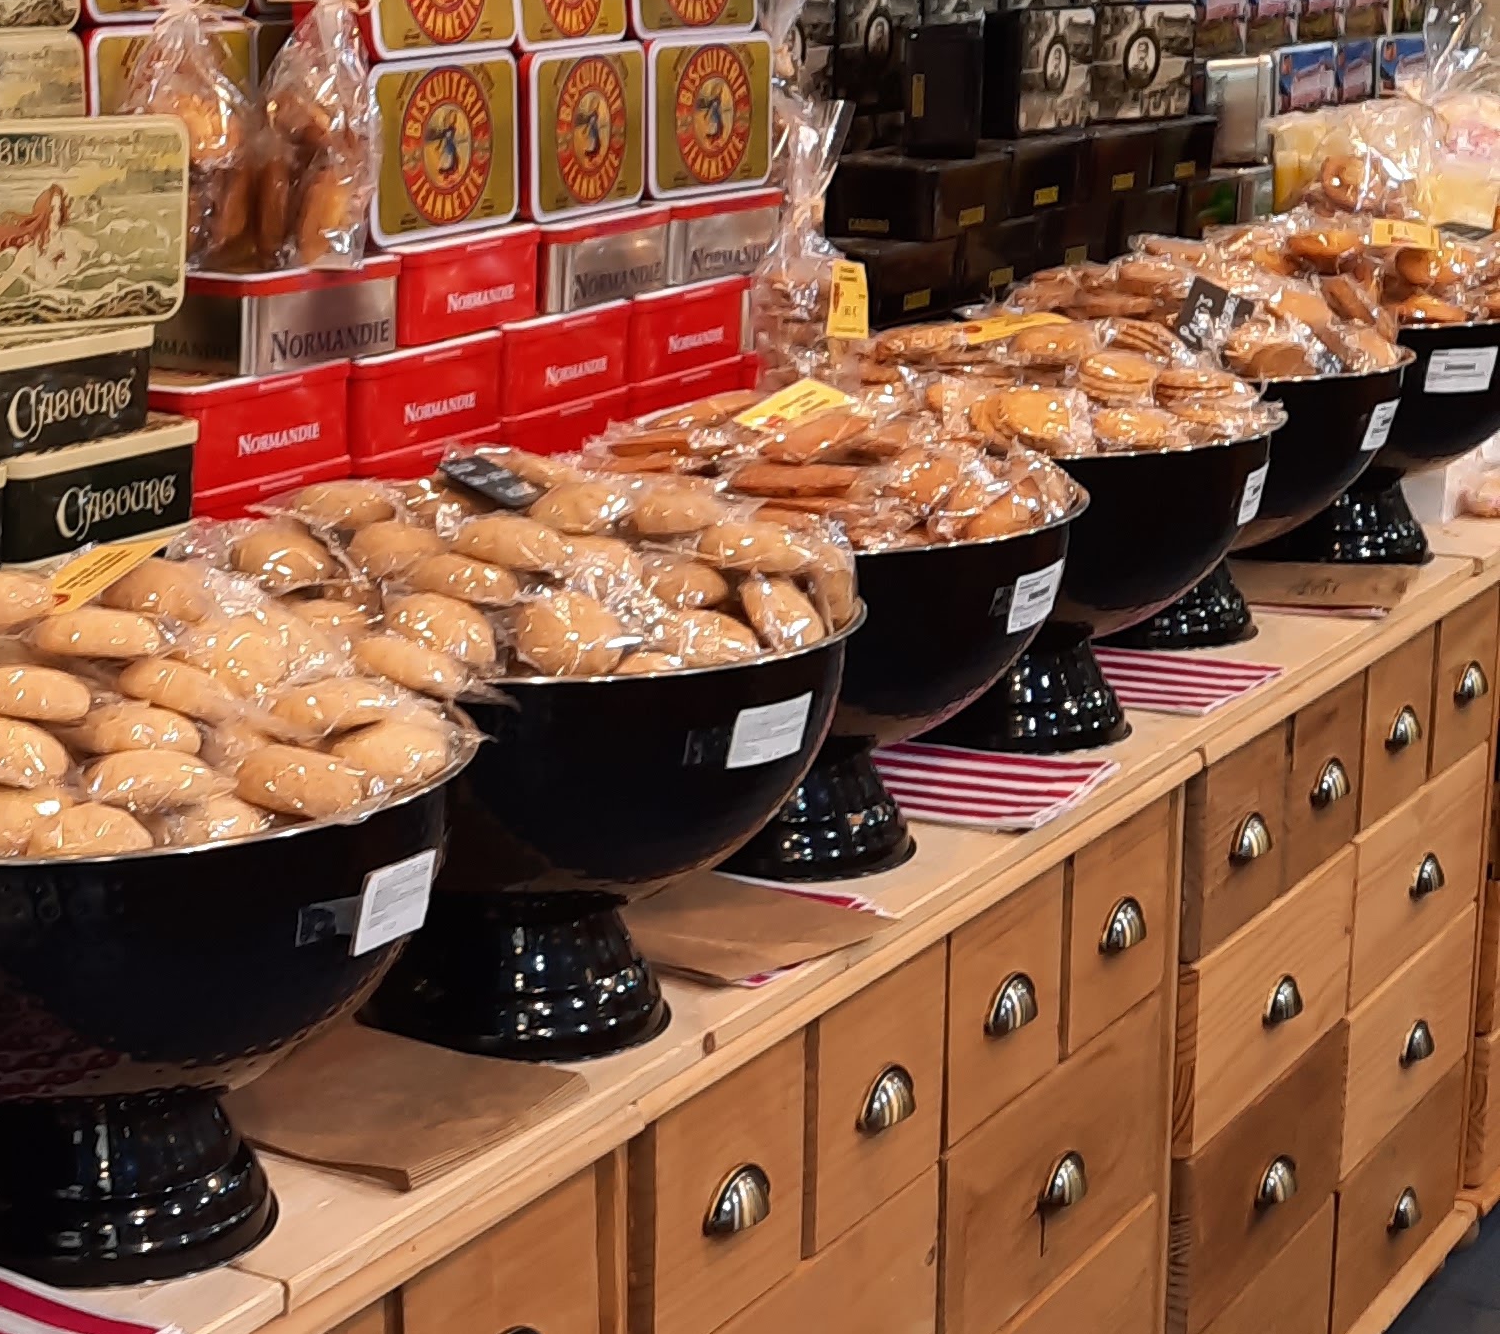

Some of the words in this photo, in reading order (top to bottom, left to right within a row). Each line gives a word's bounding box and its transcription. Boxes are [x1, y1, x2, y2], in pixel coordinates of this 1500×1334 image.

[558, 57, 623, 123] BISCUITERIE
[679, 45, 750, 107] BISCUITERIE
[405, 69, 488, 138] BISCUITERIE
[684, 138, 745, 182] JEANNETTE
[413, 169, 486, 223] JEANNETTE
[446, 283, 516, 314] NORMANDIE
[572, 259, 666, 303] NORMANDIE
[269, 317, 392, 365] NORMANDIE
[667, 326, 725, 355] NORMANDIE
[544, 354, 608, 387] NORMANDIE
[7, 370, 137, 442] CABOURG
[403, 391, 477, 425] NORMANDIE
[236, 421, 321, 457] NORMANDIE
[55, 475, 177, 544] CABOURG
